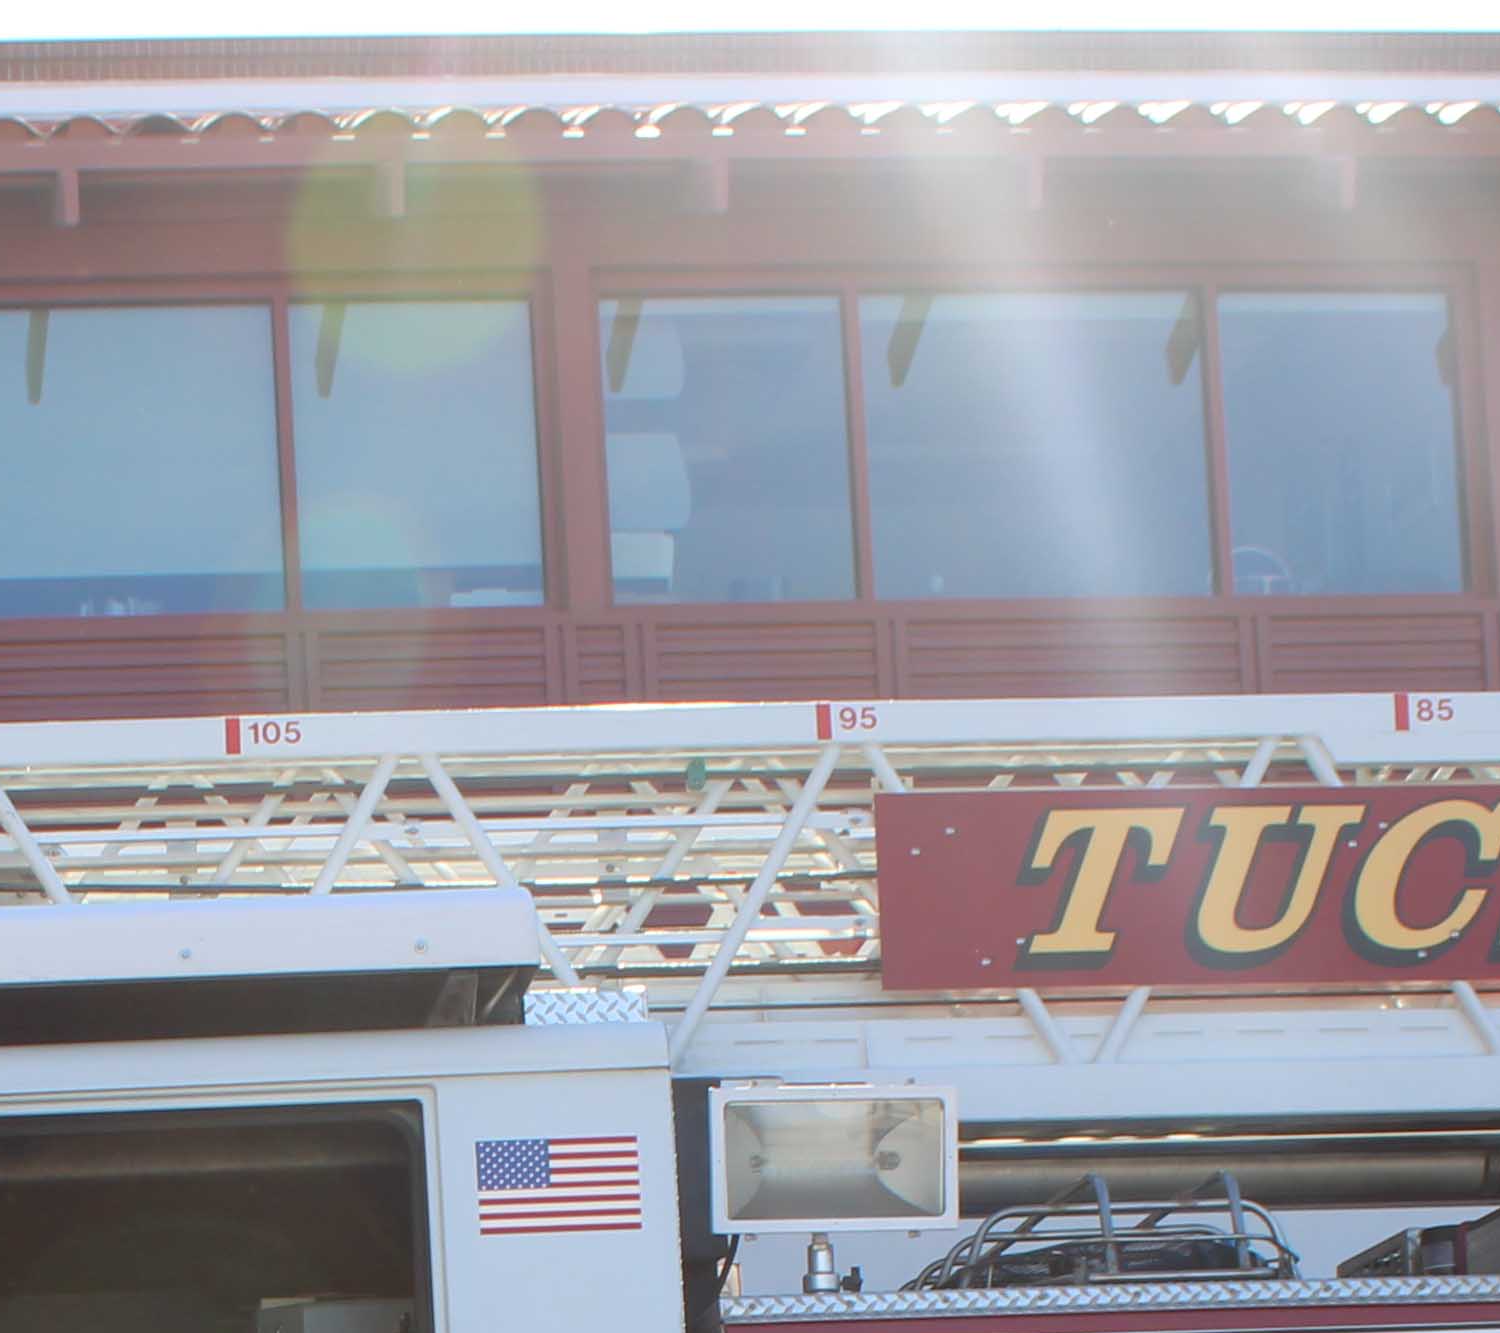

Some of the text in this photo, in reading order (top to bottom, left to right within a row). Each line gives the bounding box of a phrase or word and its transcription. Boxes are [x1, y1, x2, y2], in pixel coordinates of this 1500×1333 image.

[839, 707, 877, 730] 95
[1416, 698, 1454, 722] 85
[248, 721, 301, 745] 105
